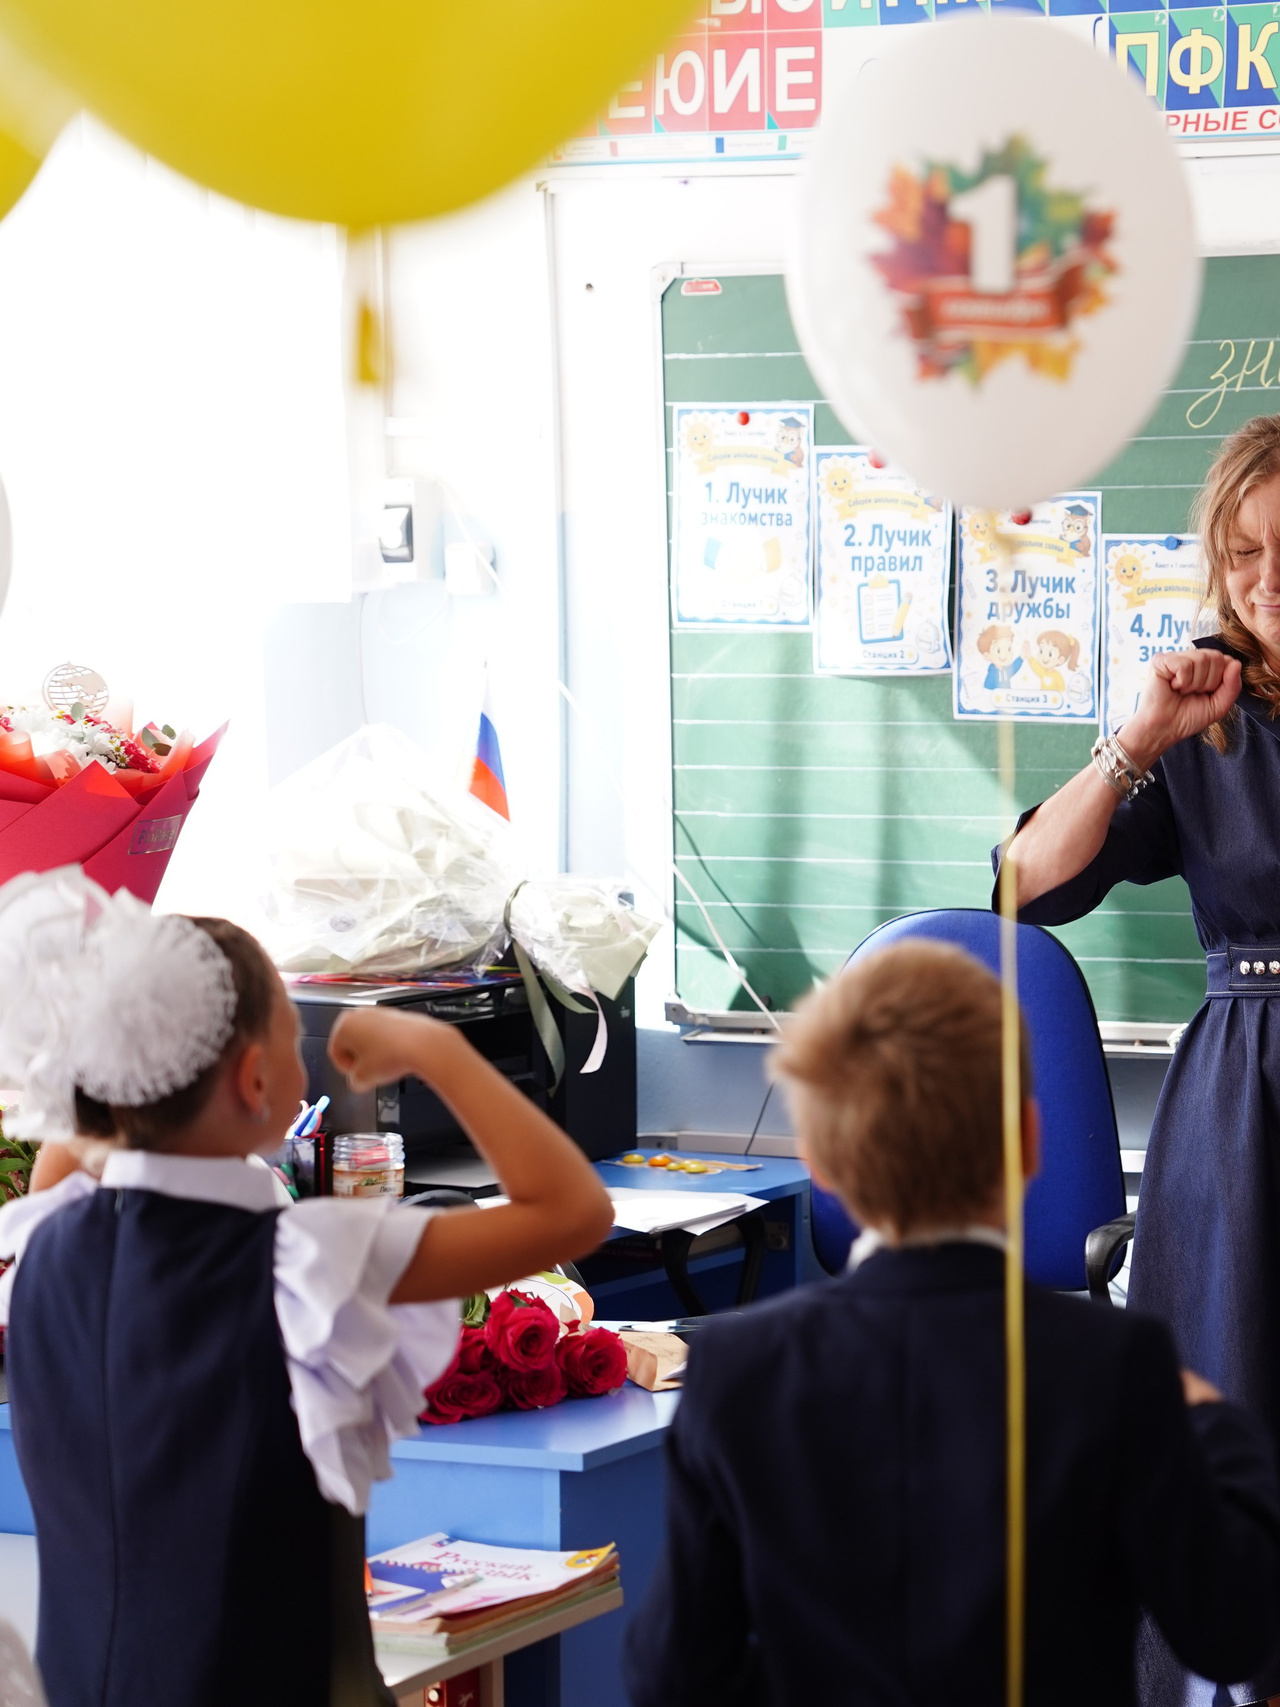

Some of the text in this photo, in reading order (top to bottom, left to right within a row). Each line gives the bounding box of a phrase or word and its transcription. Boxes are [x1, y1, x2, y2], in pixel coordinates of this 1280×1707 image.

[1166, 111, 1249, 133] РНЫЕ
[705, 481, 788, 509] 1. Лучик
[702, 511, 793, 527] знакомства
[844, 523, 932, 553] 2. Лучик
[851, 555, 923, 577] правил
[1011, 569, 1076, 599] Лучик
[987, 597, 1070, 624] дружбы
[1130, 613, 1151, 638] 4.
[1043, 694, 1048, 703] 3
